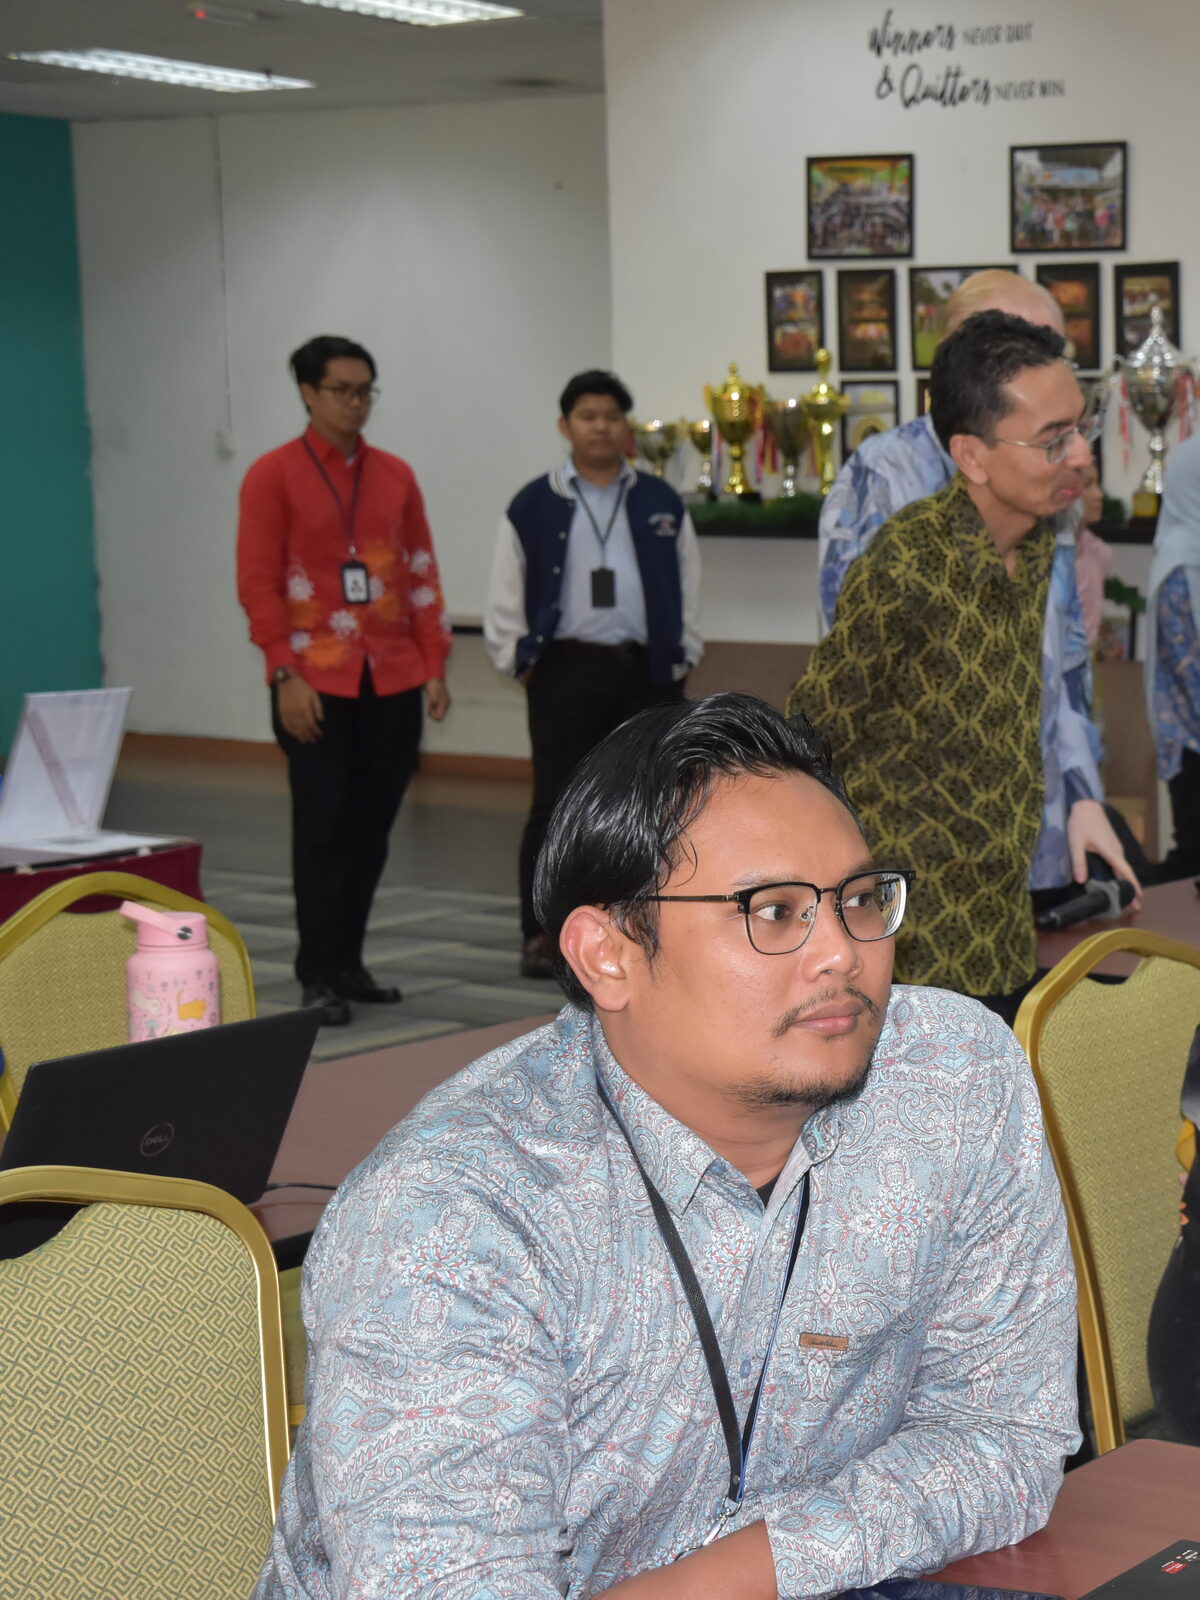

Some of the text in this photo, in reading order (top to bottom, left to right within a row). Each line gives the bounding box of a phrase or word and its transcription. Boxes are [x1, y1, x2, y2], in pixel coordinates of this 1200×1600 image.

[868, 8, 1033, 57] Winners NEVER QUIT
[876, 63, 1066, 109] & Quitters NEVER WIN
